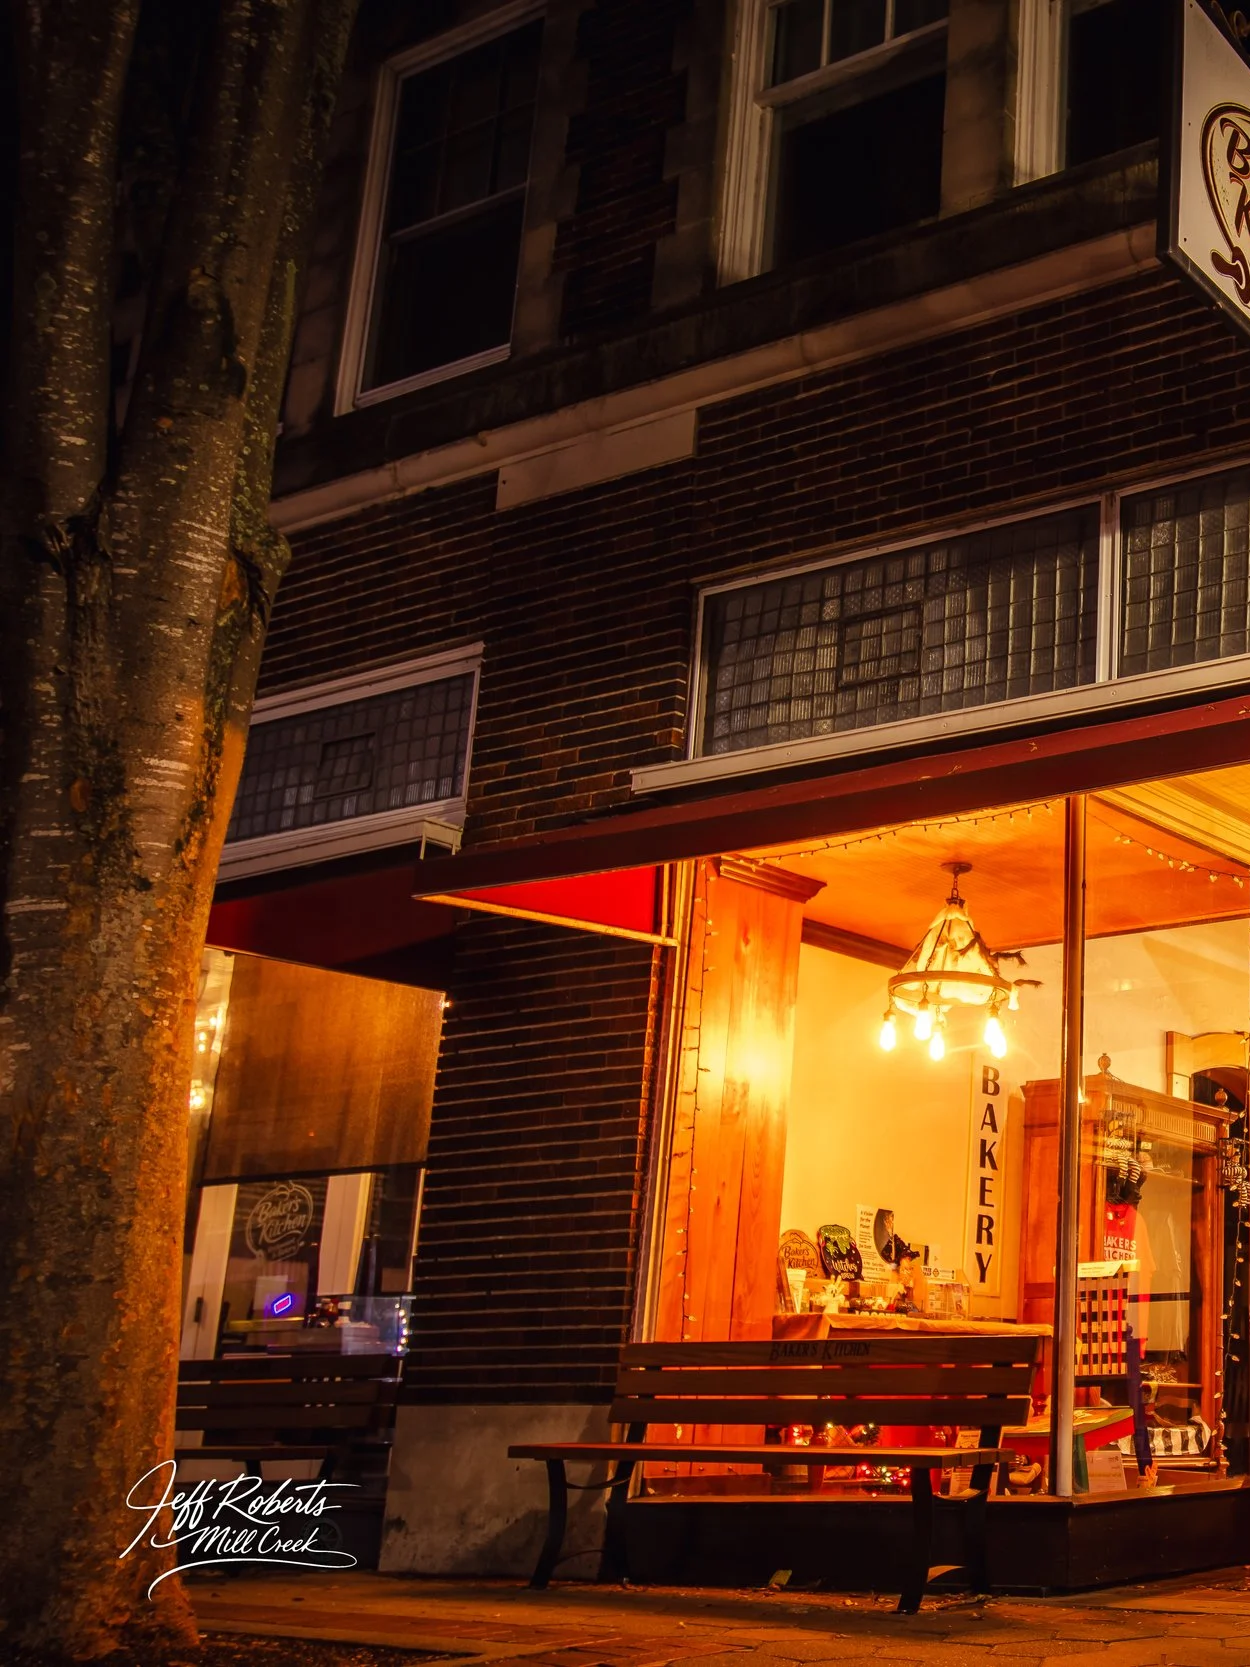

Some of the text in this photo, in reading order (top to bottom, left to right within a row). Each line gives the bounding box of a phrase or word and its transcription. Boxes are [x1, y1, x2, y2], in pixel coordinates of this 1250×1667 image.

[975, 1065, 1000, 1283] BAKERY
[259, 1197, 300, 1222] Baker's
[258, 1214, 306, 1244] Kitchen
